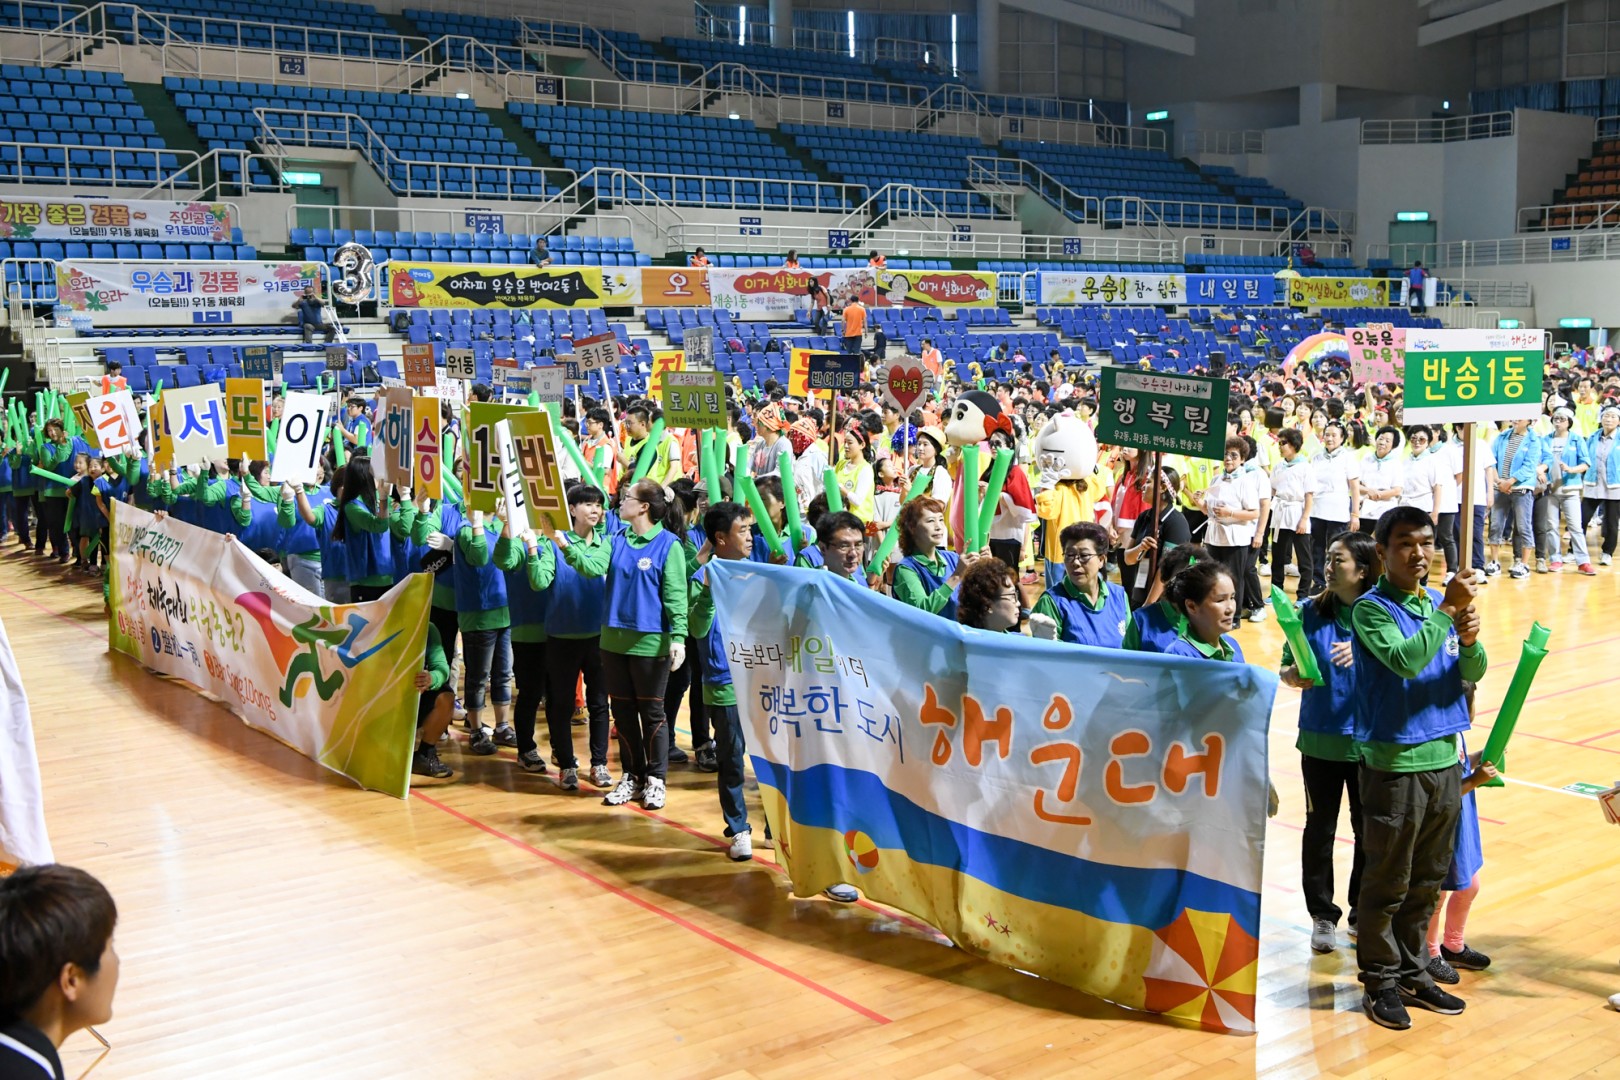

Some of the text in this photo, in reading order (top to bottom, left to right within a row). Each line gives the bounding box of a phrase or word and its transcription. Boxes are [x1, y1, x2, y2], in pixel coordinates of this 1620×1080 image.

[283, 63, 301, 74] 4-2
[538, 84, 553, 94] 4-3
[3, 203, 41, 225] 가장
[47, 204, 86, 226] 좋은
[90, 204, 130, 226] 경품
[169, 211, 214, 224] 주인공은
[110, 227, 131, 238] 우1동
[135, 227, 159, 238] 체육회
[480, 222, 500, 234] 2-3
[831, 237, 846, 248] 2-4
[1065, 244, 1079, 254] 2-5
[131, 270, 194, 294] 우승과
[200, 271, 239, 294] 경품
[333, 242, 374, 305] 3
[744, 278, 769, 289] 이거
[450, 276, 487, 291] 어차피
[492, 279, 527, 294] 우승은
[529, 279, 571, 294] 반여2동
[919, 280, 939, 292] 이거
[941, 282, 975, 297] 실화냐?
[1081, 274, 1127, 302] 우승!
[192, 297, 215, 308] 우1동
[218, 297, 245, 308] 체육회
[1352, 331, 1393, 346] 오늘은
[1511, 333, 1537, 349] 해운대
[448, 355, 474, 375] 우1동
[581, 343, 615, 368] 중1동
[811, 371, 855, 387] 반여1동
[892, 380, 919, 393] 재송2동
[1141, 377, 1173, 393] 우승은!
[1423, 356, 1527, 401] 반송1동
[669, 391, 720, 413] 도시팀
[179, 400, 226, 447] 서
[230, 396, 262, 437] 또
[285, 409, 325, 469] 이
[388, 405, 411, 469] 해
[416, 418, 439, 482] 승
[514, 436, 560, 509] 반
[730, 641, 784, 671] 오늘보다
[759, 684, 904, 764] 행복한 도시
[919, 683, 1223, 826] 해운대
